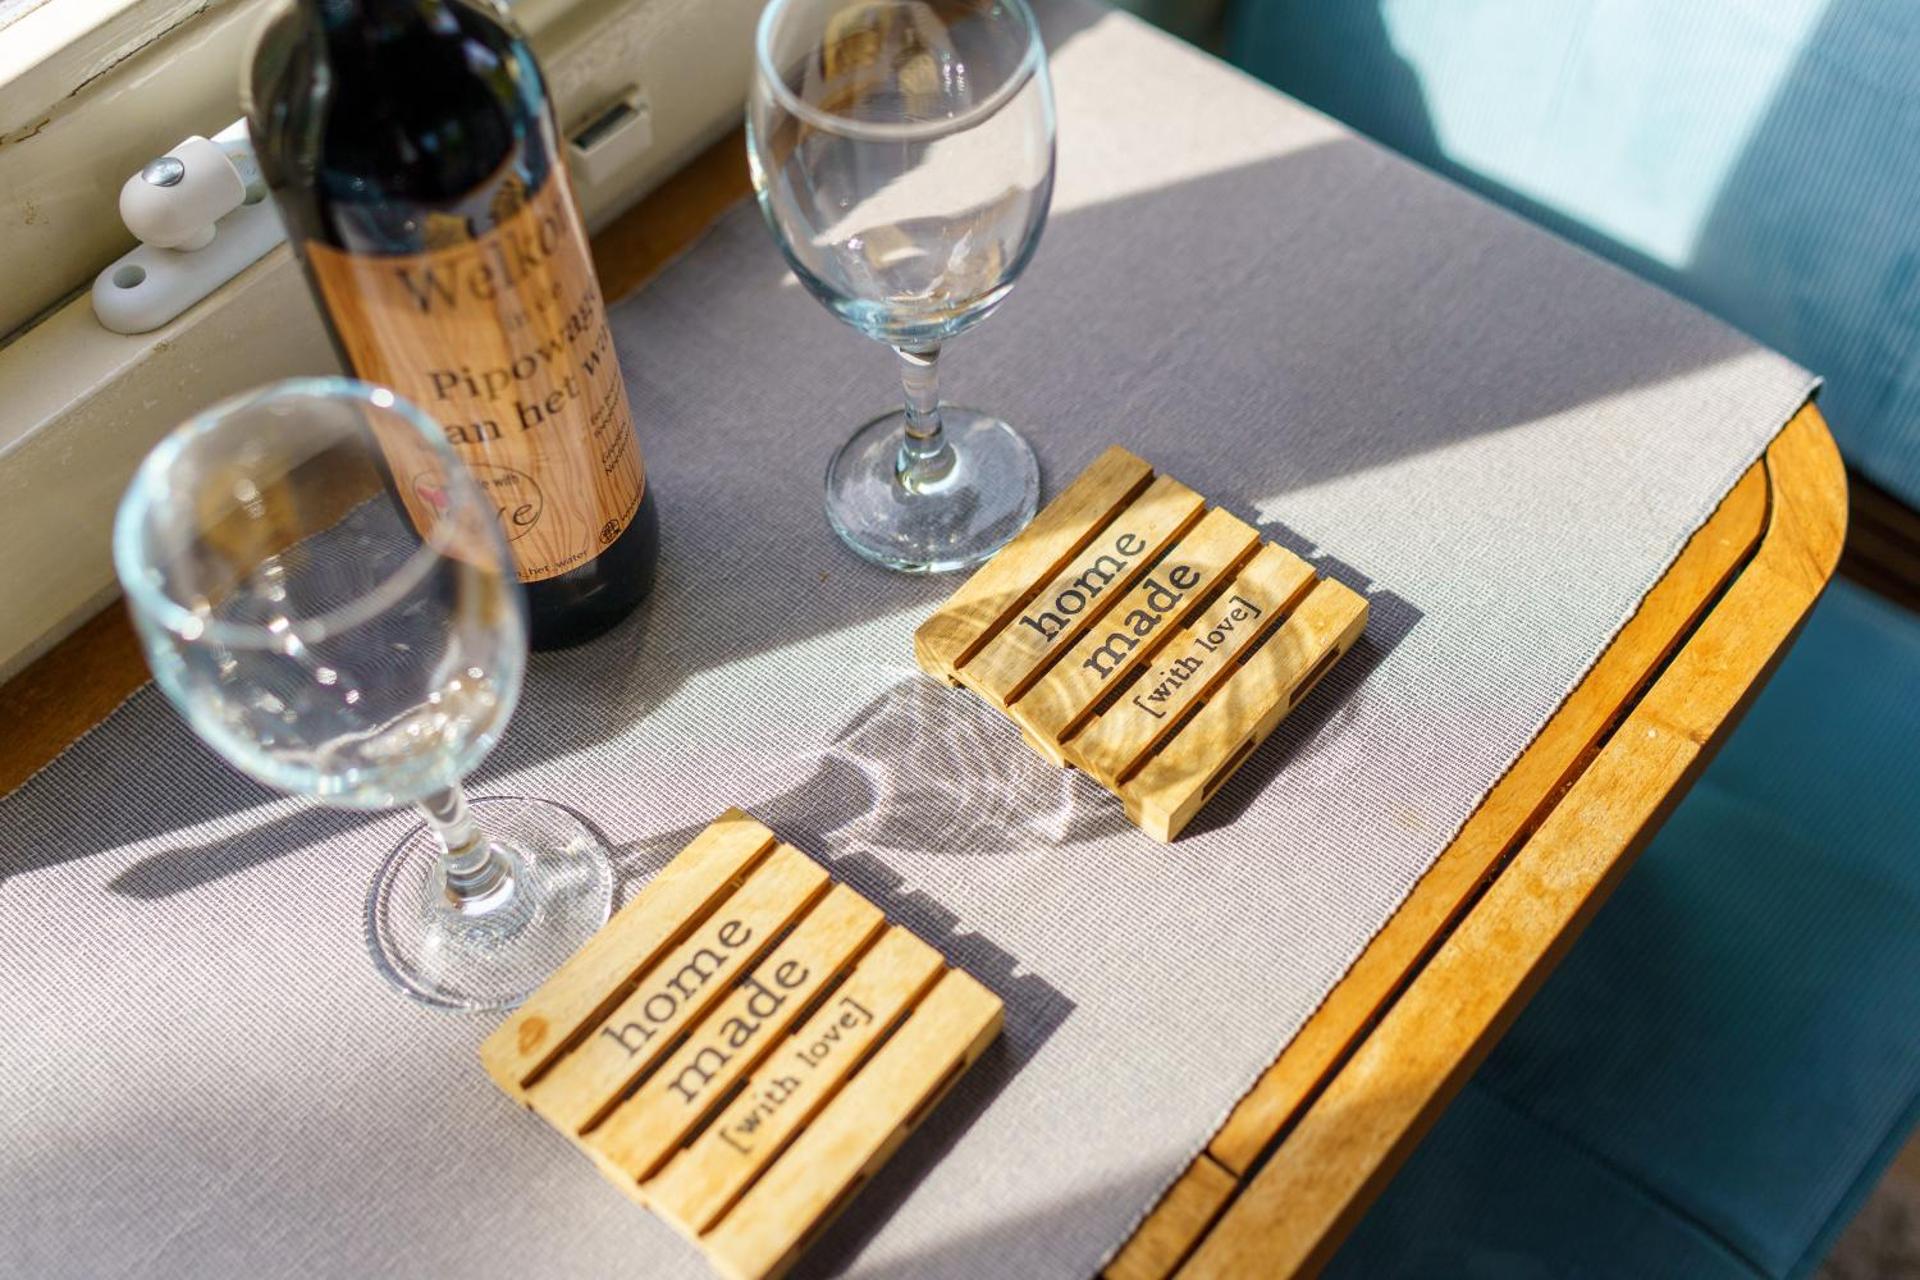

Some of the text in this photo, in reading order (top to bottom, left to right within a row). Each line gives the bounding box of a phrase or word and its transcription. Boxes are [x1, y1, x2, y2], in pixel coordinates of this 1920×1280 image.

[438, 417, 504, 447] an
[513, 374, 581, 433] het
[1019, 533, 1147, 643] home
[1082, 562, 1201, 679] made
[1133, 595, 1262, 719] [with love]
[603, 916, 753, 1059] home
[667, 957, 810, 1106] made
[719, 998, 872, 1156] [with love]
